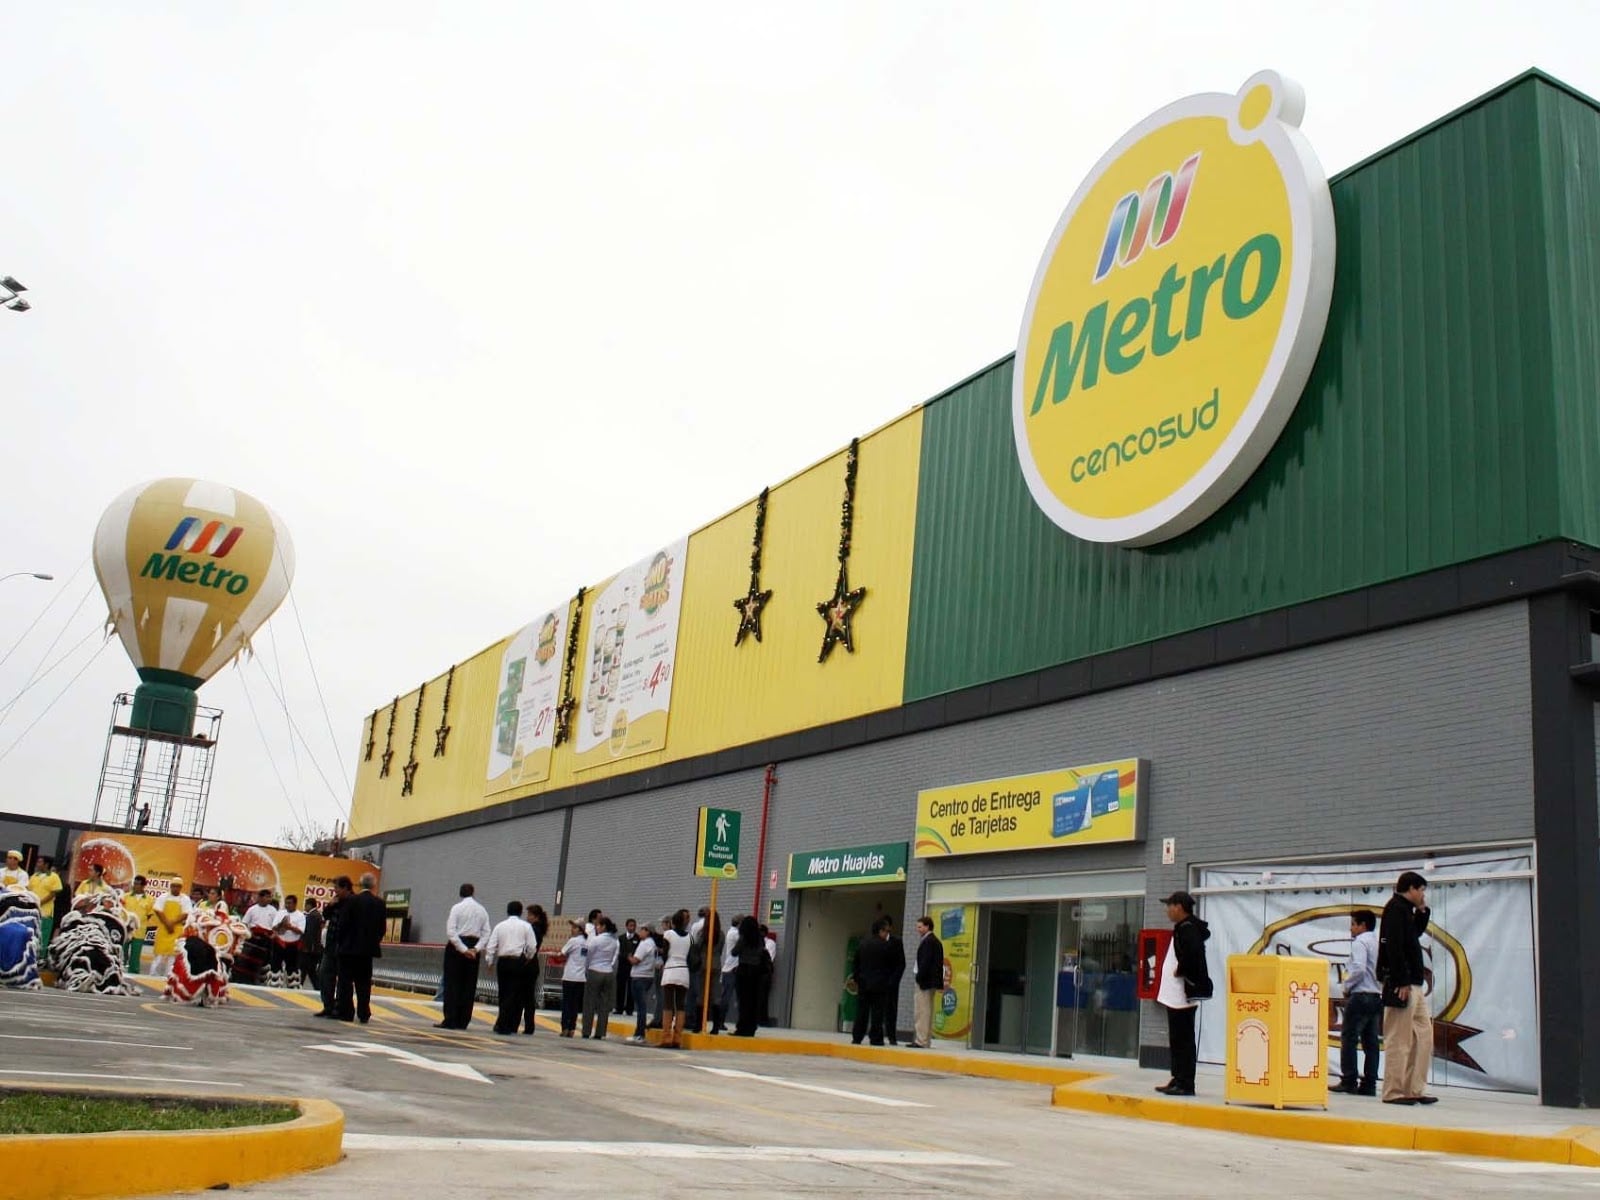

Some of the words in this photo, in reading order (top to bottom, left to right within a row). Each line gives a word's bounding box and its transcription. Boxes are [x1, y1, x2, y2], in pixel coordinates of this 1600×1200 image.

[1030, 233, 1282, 417] Metro
[1070, 388, 1219, 483] cencosud
[140, 552, 249, 595] Metro
[930, 799, 968, 818] Centro
[971, 794, 987, 813] de
[990, 790, 1040, 811] Entrega
[950, 819, 965, 837] de
[968, 815, 1017, 838] Tarjetas
[708, 851, 734, 860] Peatonal
[712, 844, 730, 852] Cruce
[808, 856, 839, 875] Metro
[842, 852, 885, 875] Huaylas
[306, 887, 325, 897] NO
